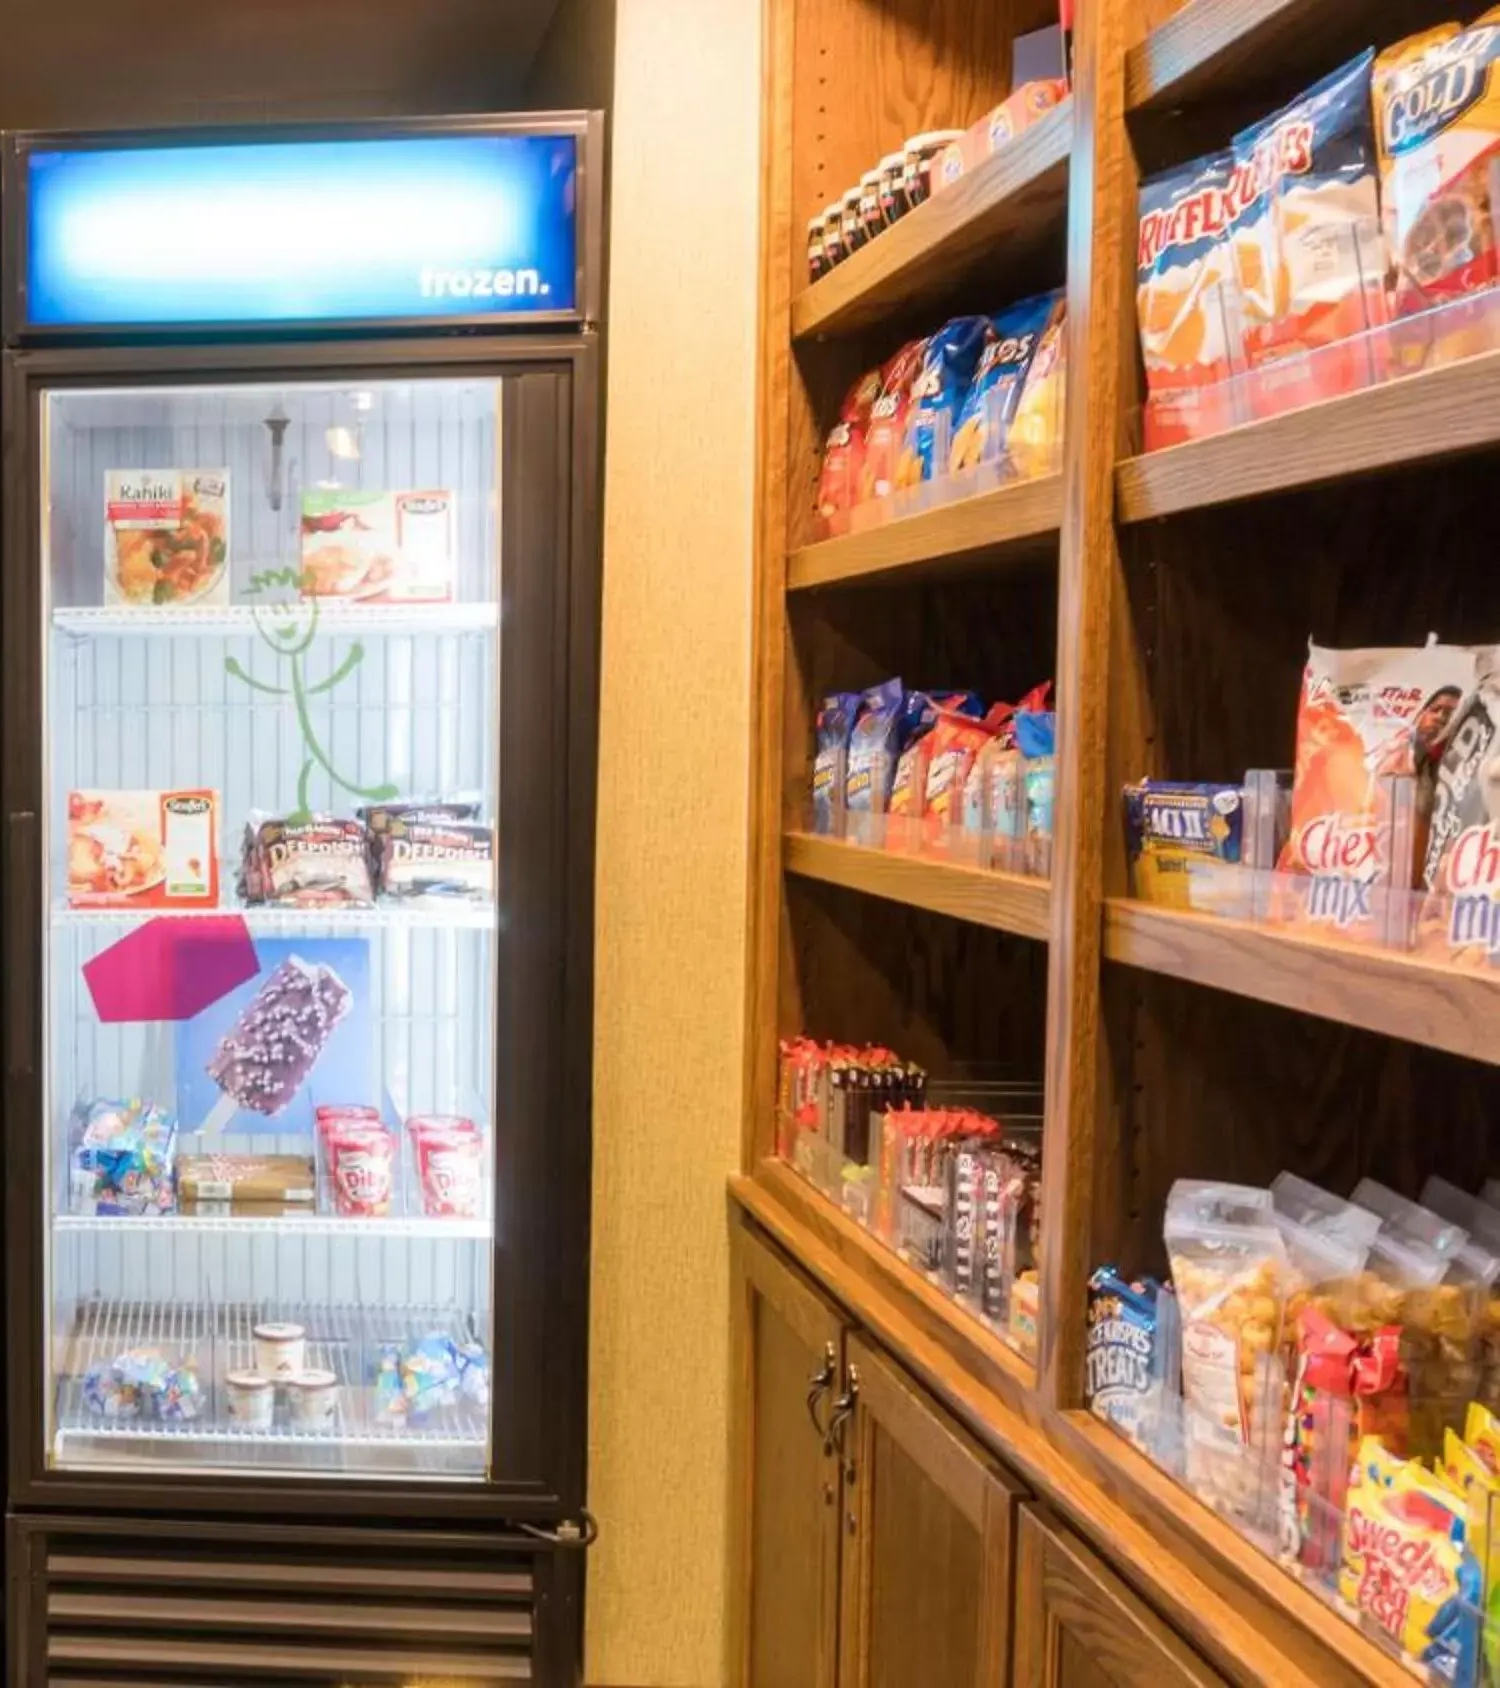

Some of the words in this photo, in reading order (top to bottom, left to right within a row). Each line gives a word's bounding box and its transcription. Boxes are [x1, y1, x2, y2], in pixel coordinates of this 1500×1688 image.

[1386, 57, 1476, 148] GOLD
[1137, 186, 1226, 268] RUFFL
[419, 267, 551, 299] frozen.
[1150, 807, 1182, 838] ACT
[1300, 816, 1387, 870] Chex
[1310, 872, 1379, 922] mix
[1086, 1345, 1149, 1395] TREATS
